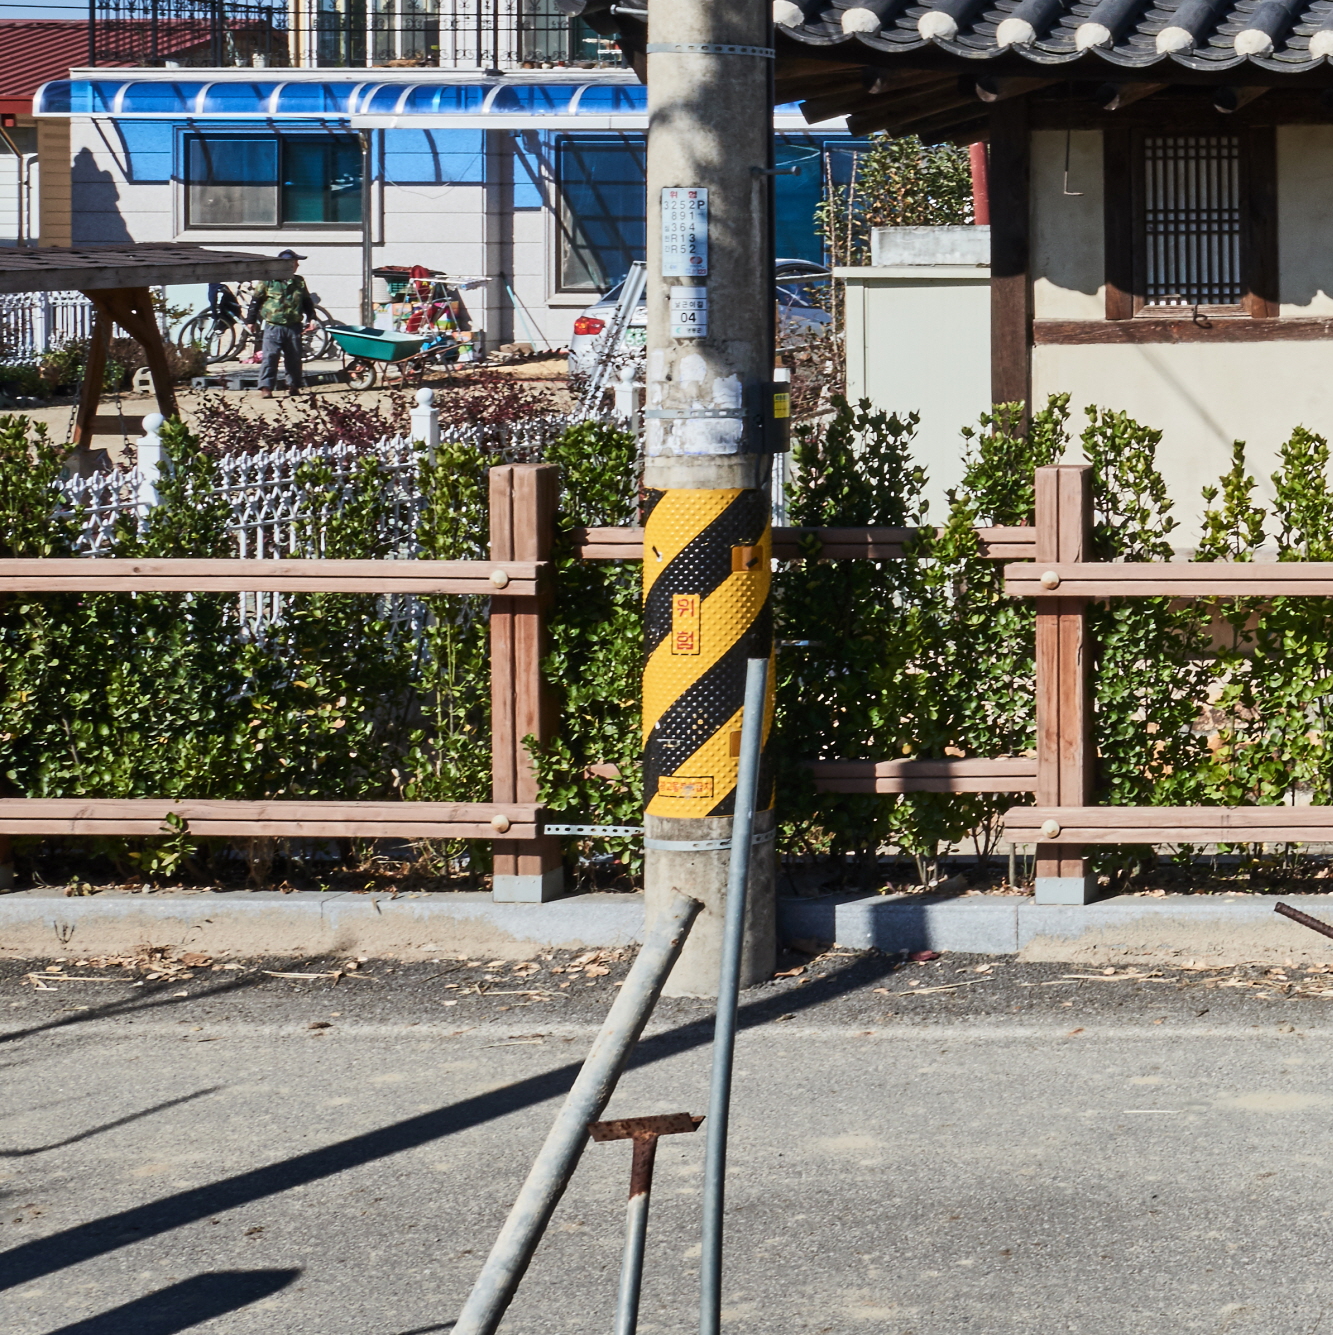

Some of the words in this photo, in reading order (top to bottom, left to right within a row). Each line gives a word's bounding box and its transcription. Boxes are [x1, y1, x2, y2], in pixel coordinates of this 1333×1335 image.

[664, 200, 705, 210] 3252P
[671, 211, 695, 220] 891
[671, 223, 696, 232] 364
[671, 233, 696, 243] R13
[671, 244, 697, 254] R52
[680, 312, 697, 323] 04
[676, 598, 695, 650] 위험
